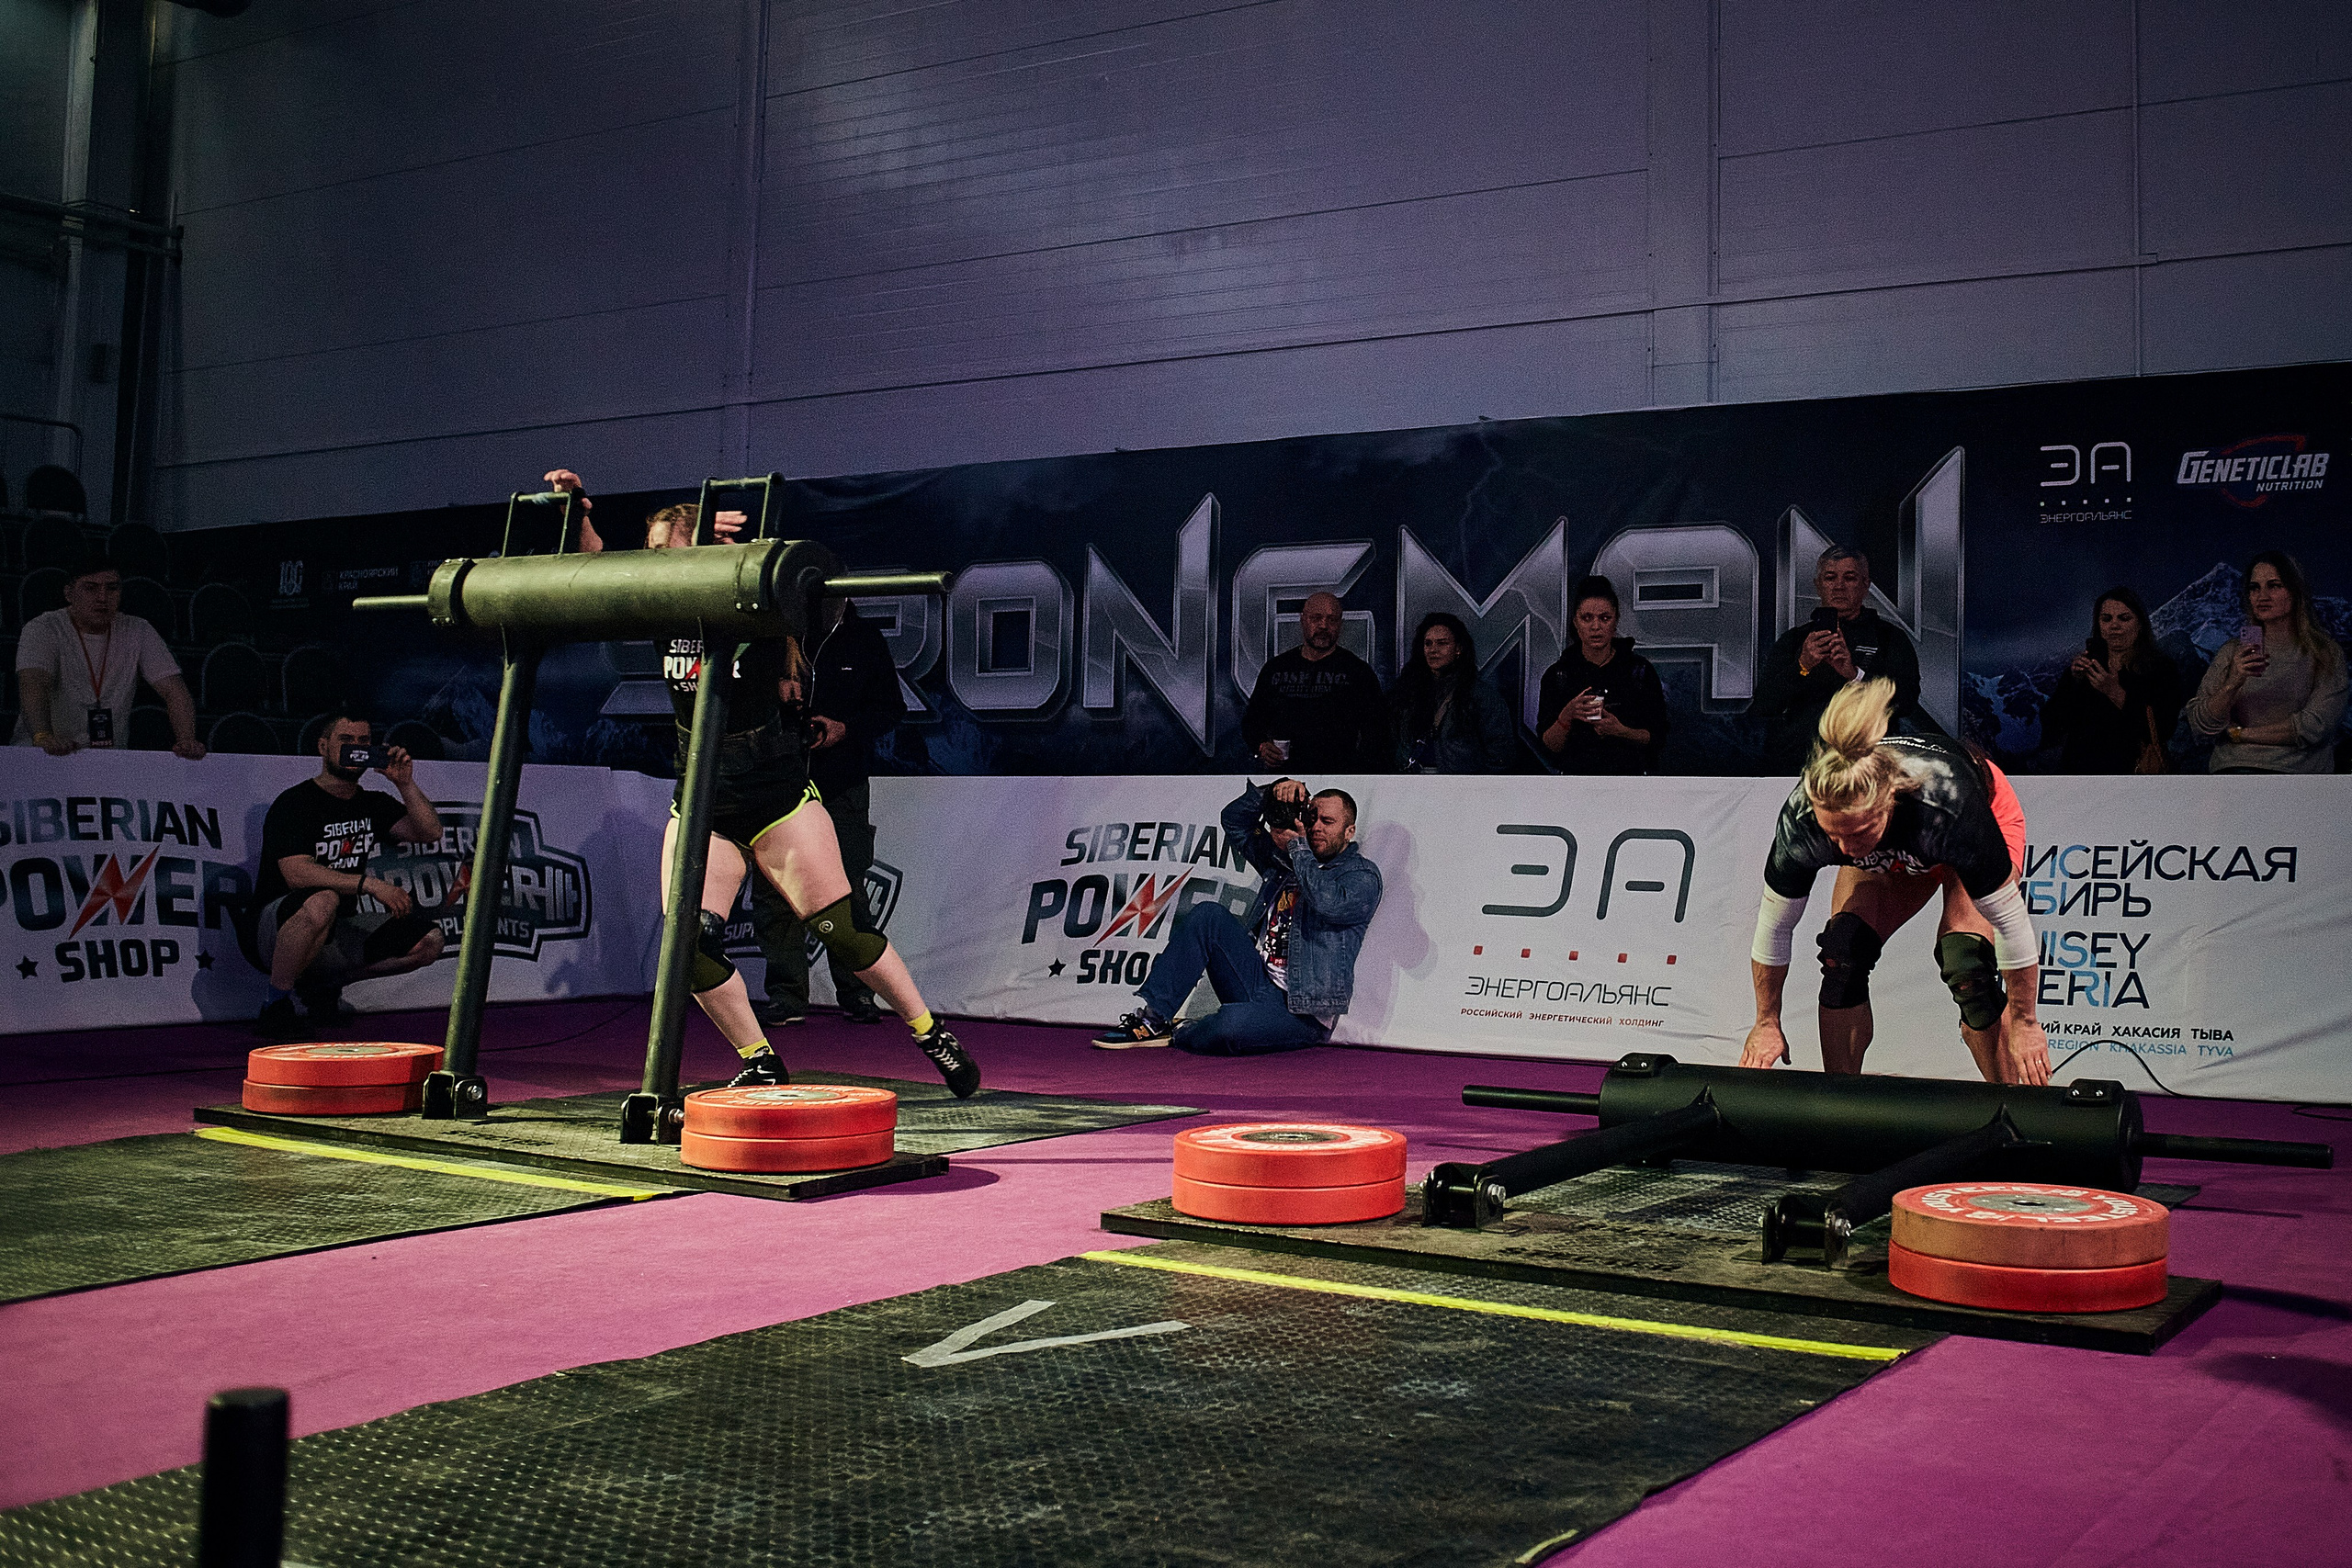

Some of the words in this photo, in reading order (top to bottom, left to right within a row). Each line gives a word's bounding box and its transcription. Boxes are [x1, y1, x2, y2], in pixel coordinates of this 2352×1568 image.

[2256, 479, 2324, 493] NUTRITION
[2039, 510, 2133, 525] ЭНЕРГОАЛЬЯНС
[323, 817, 372, 839] SIBERIAN
[1060, 822, 1247, 874] SIBERIAN
[2022, 840, 2297, 883] ИСЕЙСКАЯ
[0, 852, 256, 931] OWER
[1481, 824, 1696, 923] ЭА
[2018, 880, 2152, 918] БИРЬ
[55, 939, 180, 983] SHOP
[1077, 950, 1150, 986] SHO
[1464, 976, 1672, 1007] ЭНЕРГОАЛЬЯНС
[2037, 969, 2151, 1010] ERIA
[1461, 1008, 1523, 1020] РОССИЙСКИЙ
[1529, 1012, 1613, 1026] ЭНЕРГЕТИЧЕСКИЙ
[1619, 1018, 1665, 1028] ХОЛДИНГ
[2064, 1022, 2102, 1036] КРАЙ
[2111, 1025, 2181, 1040] ХАКАСИЯ
[2190, 1028, 2234, 1042] ТЫВА
[2047, 1039, 2099, 1052] REGION
[2109, 1043, 2188, 1055] KHAKASSIA
[2198, 1044, 2233, 1057] TYVA
